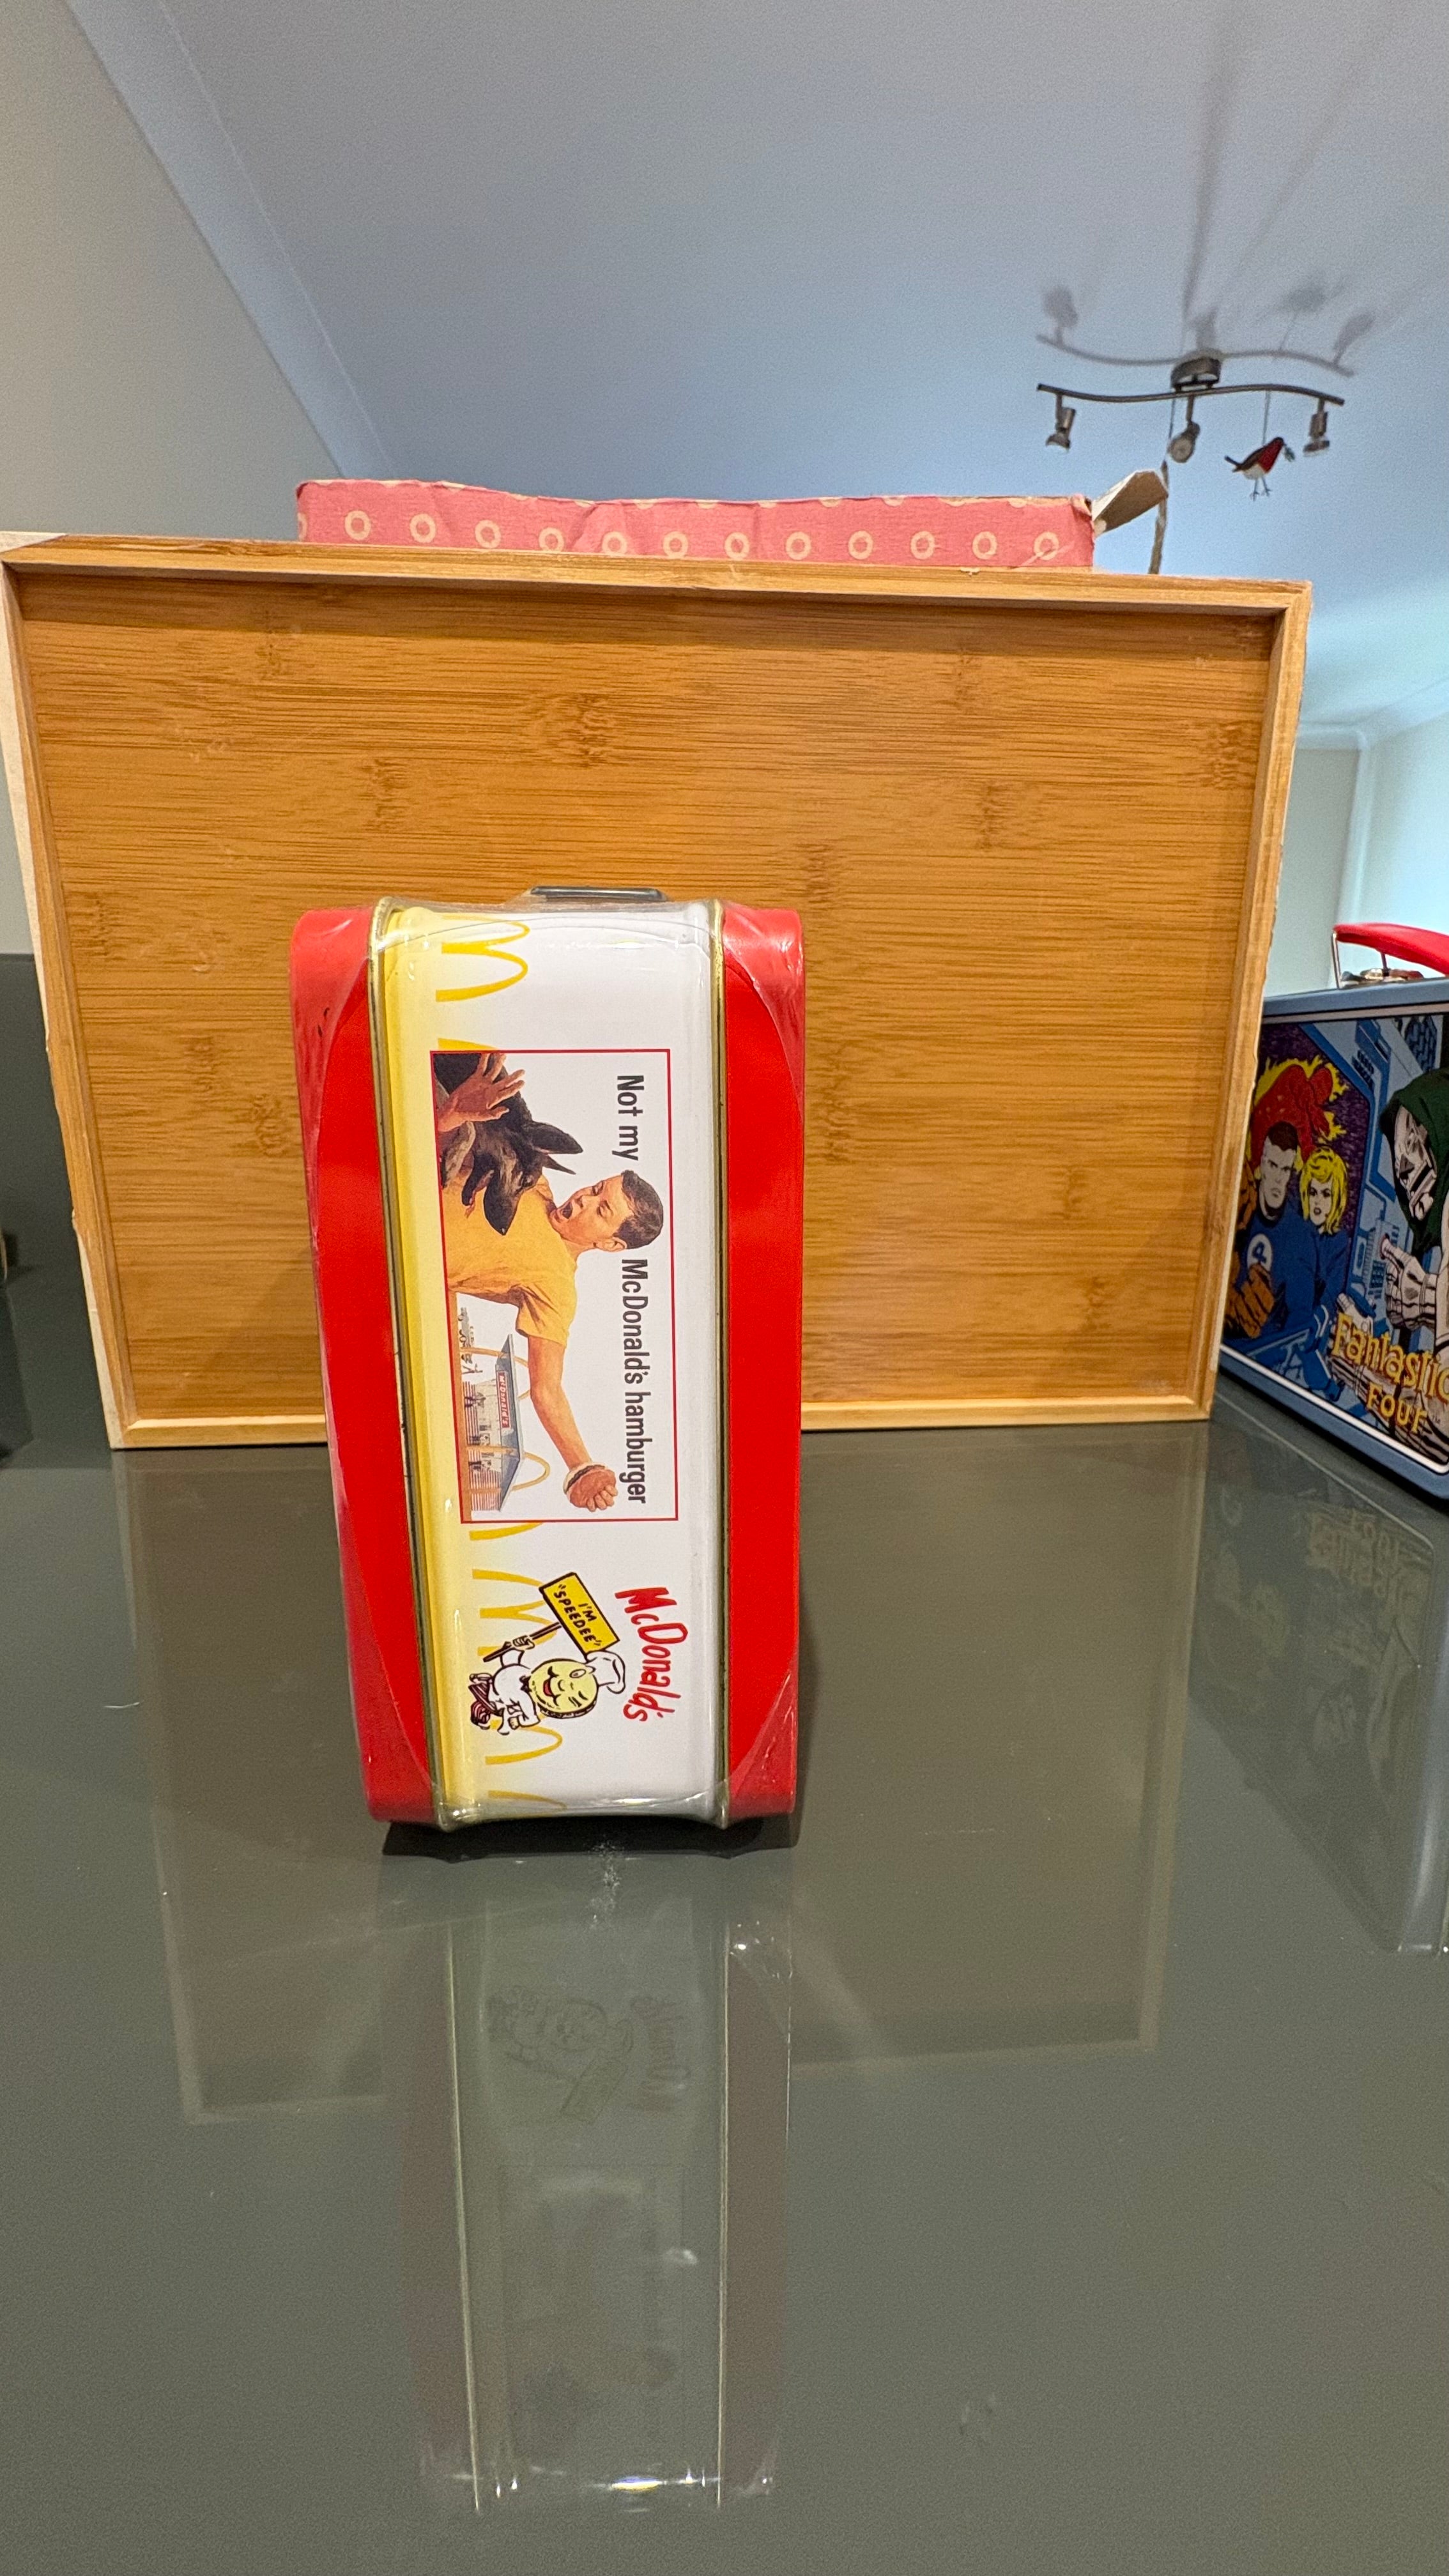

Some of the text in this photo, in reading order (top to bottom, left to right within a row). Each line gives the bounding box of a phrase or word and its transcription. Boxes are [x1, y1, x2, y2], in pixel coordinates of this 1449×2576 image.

[611, 1075, 653, 1505] Not my McDonald's hamburger
[553, 1584, 602, 1646] "SPEEDEE"
[578, 1602, 597, 1622] I'M
[614, 1586, 689, 1722] McDonald's
